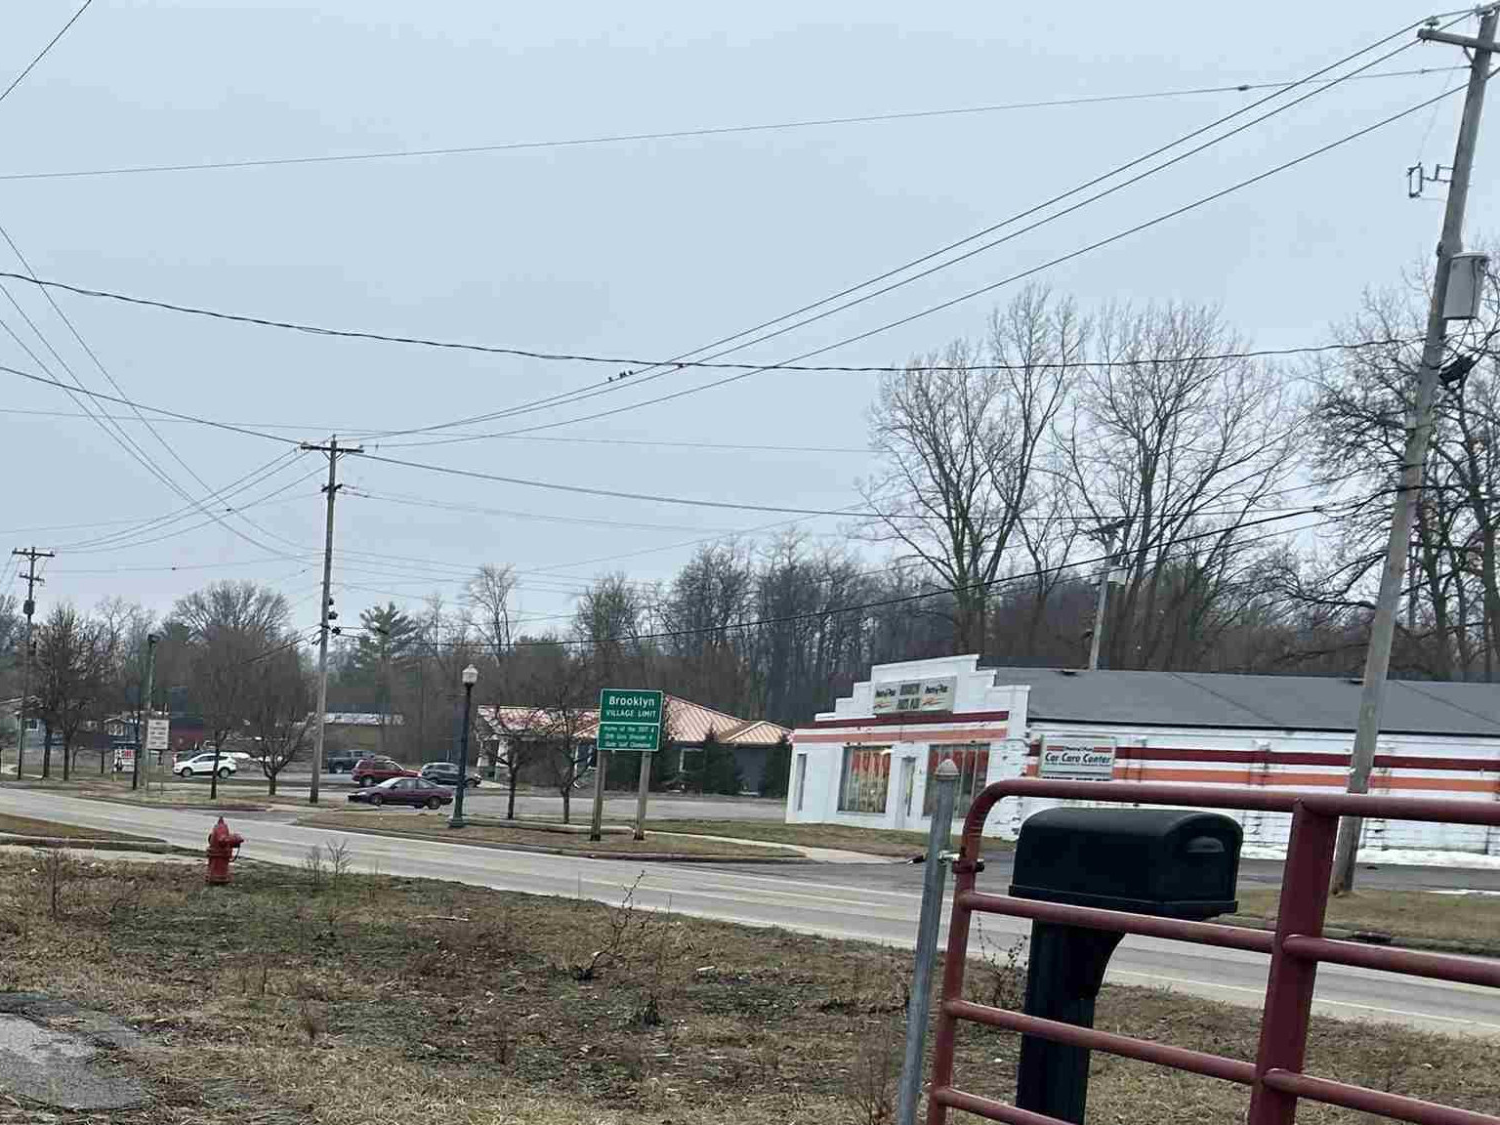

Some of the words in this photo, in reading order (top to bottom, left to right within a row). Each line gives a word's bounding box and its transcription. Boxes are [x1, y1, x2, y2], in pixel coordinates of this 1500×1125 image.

[609, 696, 655, 708] Brooklyn
[606, 709, 634, 718] VILLAGE
[638, 710, 657, 718] LIMIT
[1045, 752, 1060, 762] Car
[1062, 752, 1081, 763] Care
[1083, 754, 1112, 764] Center
